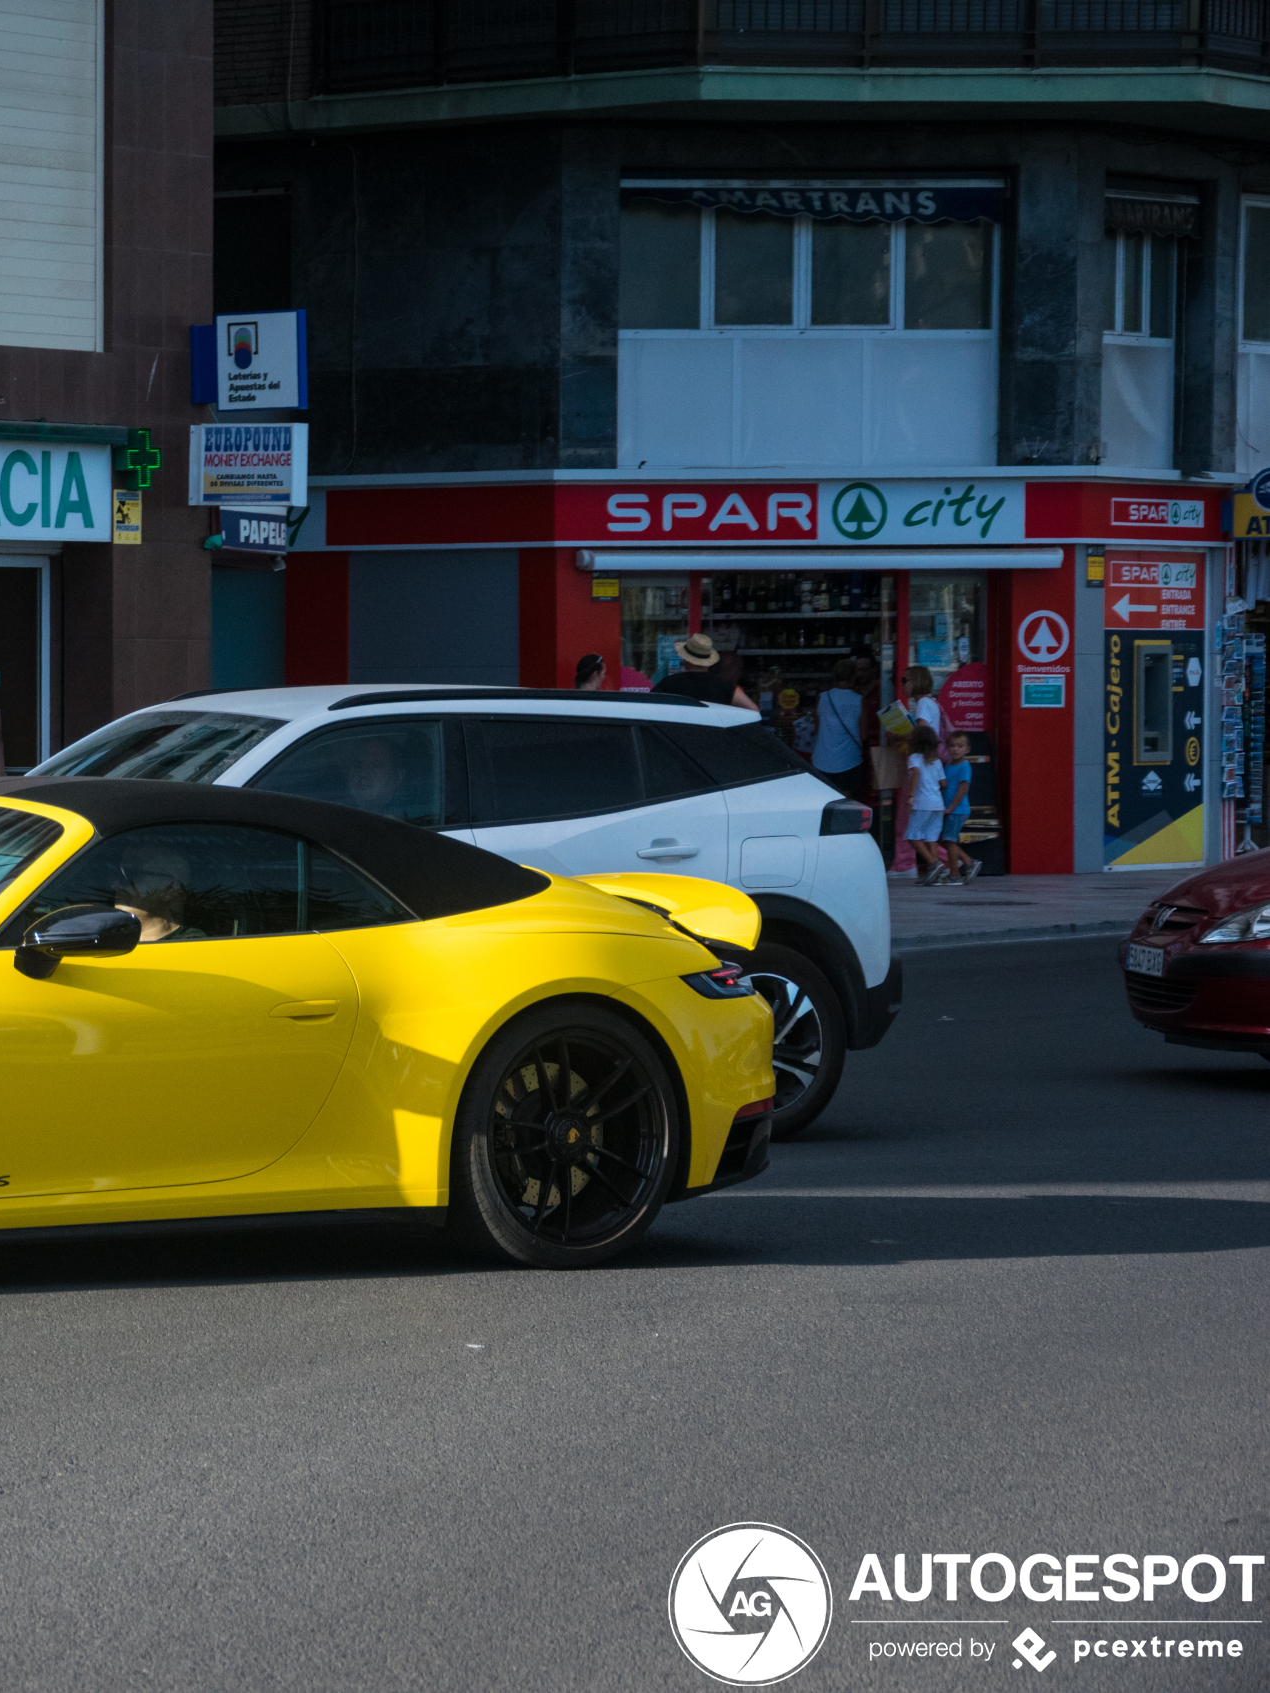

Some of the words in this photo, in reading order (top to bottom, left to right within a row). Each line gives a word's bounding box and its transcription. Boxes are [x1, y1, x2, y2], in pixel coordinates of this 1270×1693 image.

[228, 371, 261, 380] Loterías
[263, 372, 268, 381] y
[229, 383, 266, 393] Apuestas
[268, 381, 280, 389] del
[228, 393, 257, 402] Estado
[204, 426, 292, 453] EUROPOUND
[204, 454, 239, 467] MONEY
[240, 453, 292, 467] EXCHANGE
[607, 493, 812, 532] SPAR
[903, 484, 1005, 538] city
[1129, 504, 1168, 520] SPAR
[1183, 505, 1202, 525] city
[1122, 566, 1159, 580] SPAR
[1175, 565, 1196, 586] city
[1161, 589, 1191, 600] ENTRADA
[1161, 605, 1196, 615] ENTRANCE
[1017, 664, 1071, 673] Bienvenidos
[1106, 634, 1123, 735] Cajero
[949, 690, 984, 699] Domingos
[1107, 752, 1120, 828] ATM
